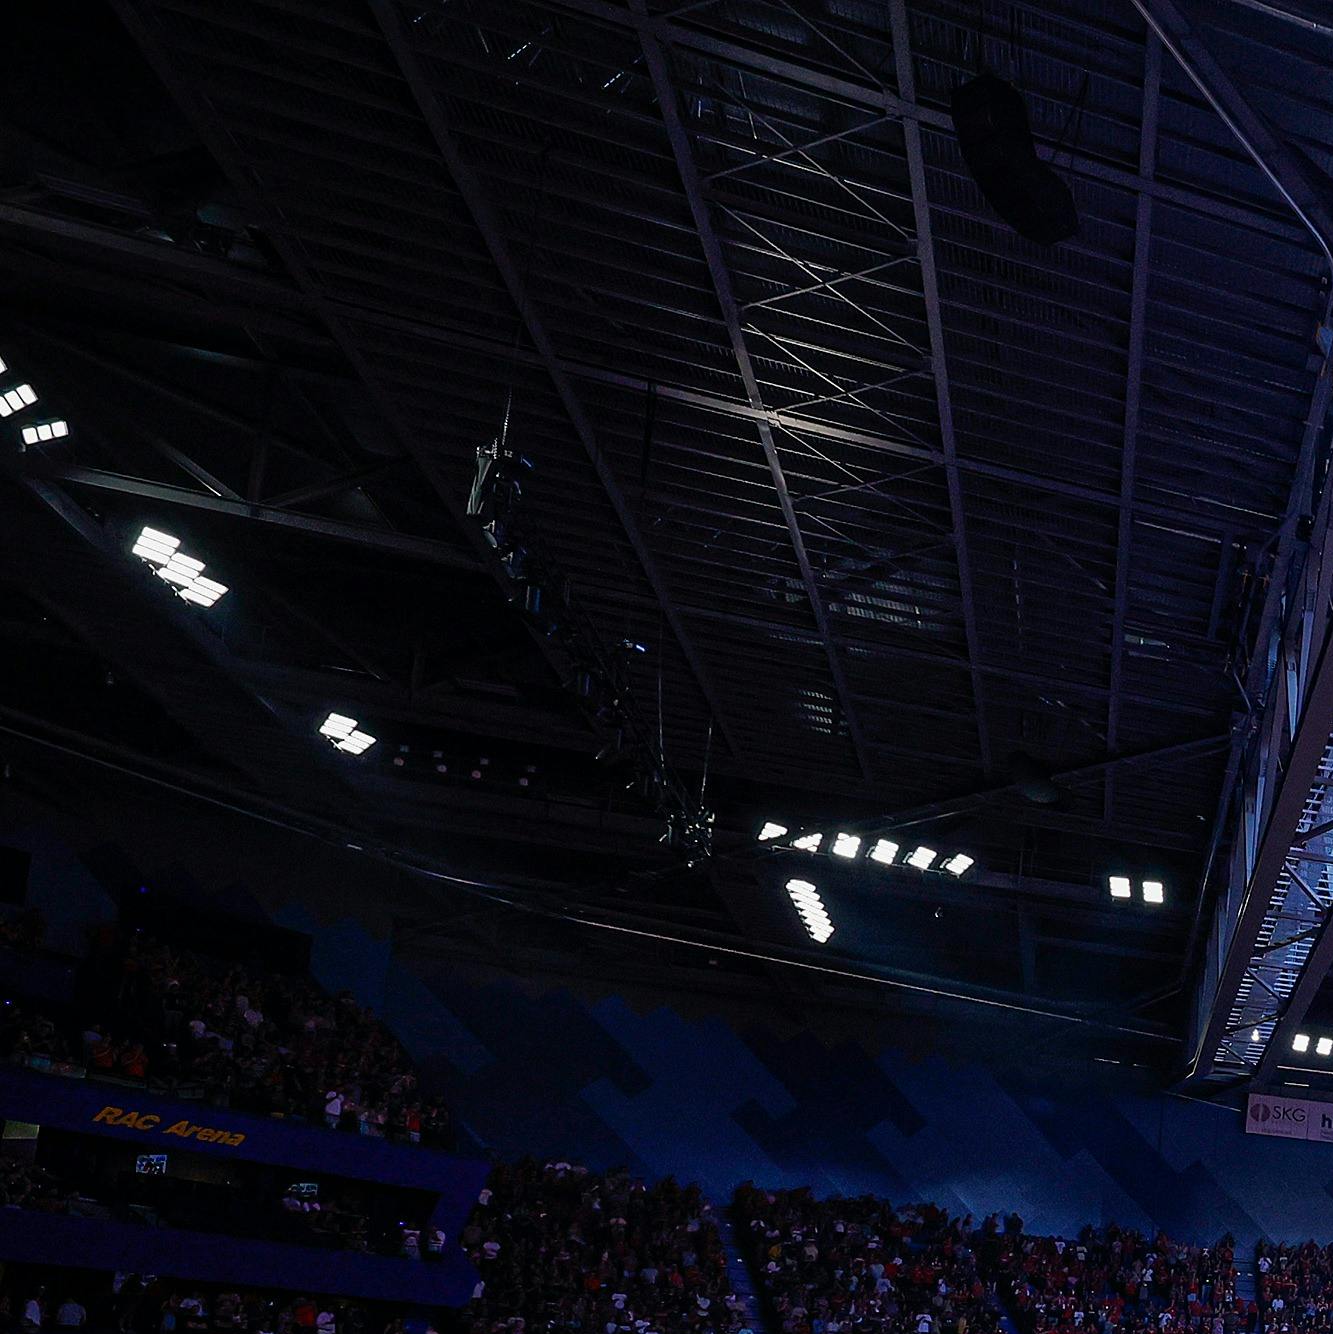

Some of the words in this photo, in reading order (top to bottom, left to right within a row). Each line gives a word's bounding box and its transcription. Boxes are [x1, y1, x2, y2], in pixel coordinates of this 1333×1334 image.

[92, 1106, 161, 1131] RAC
[163, 1120, 247, 1147] Arena
[1272, 1105, 1307, 1122] SKG
